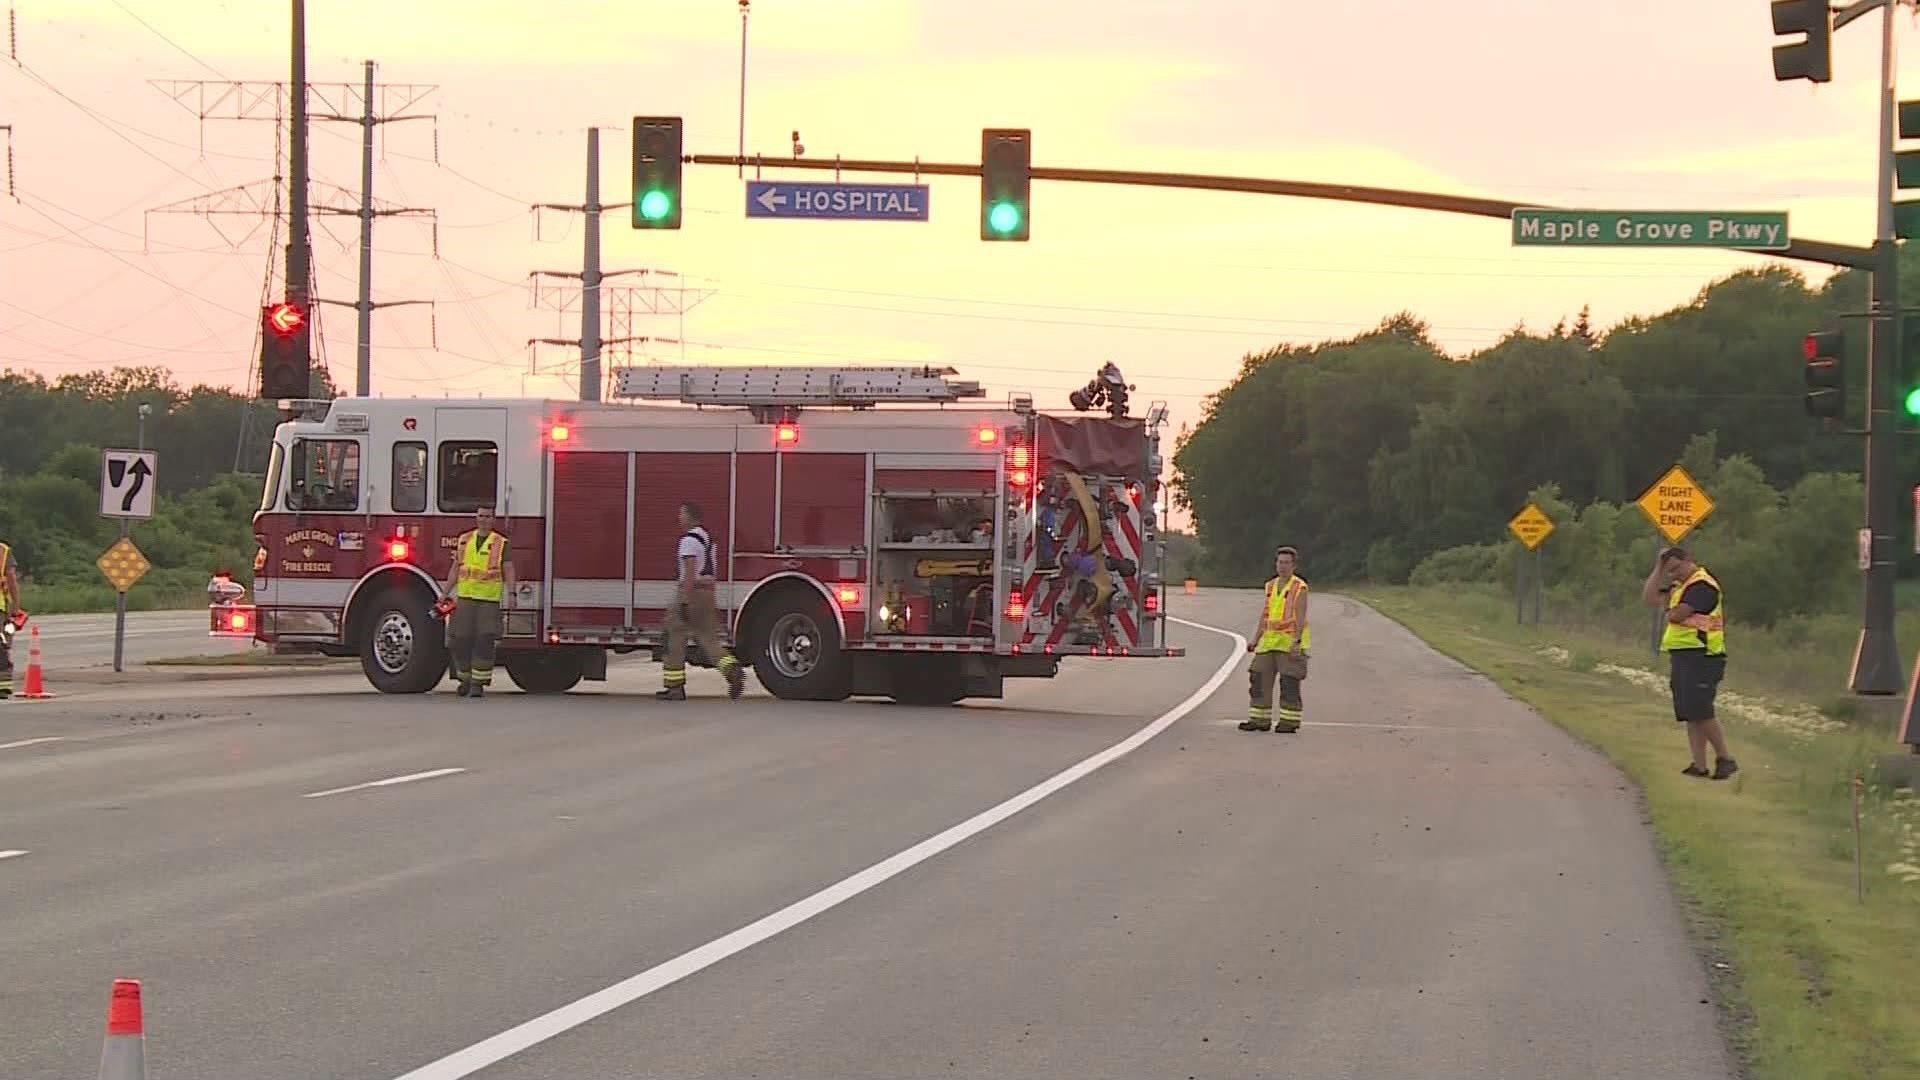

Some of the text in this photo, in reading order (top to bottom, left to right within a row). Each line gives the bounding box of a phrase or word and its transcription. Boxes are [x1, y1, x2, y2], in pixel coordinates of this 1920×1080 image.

[795, 191, 918, 212] HOSPITAL
[1520, 217, 1780, 244] Maple Grove Pkwy
[1659, 486, 1692, 497] RIGHT
[1660, 500, 1692, 511] LANE
[1660, 514, 1693, 526] ENDS
[285, 530, 336, 546] MAPLE GROVE
[284, 561, 332, 572] FIRE RESCUE
